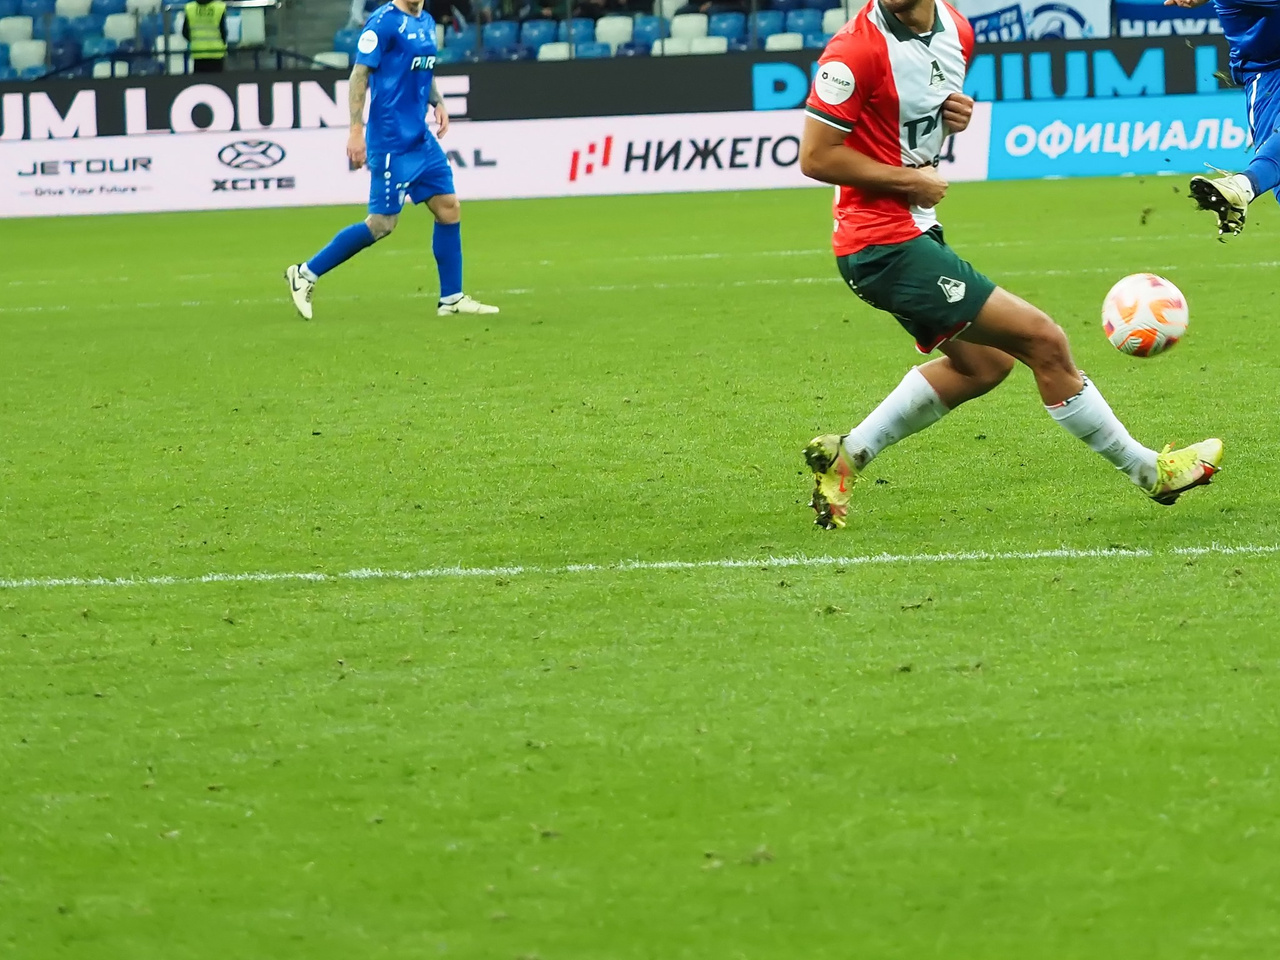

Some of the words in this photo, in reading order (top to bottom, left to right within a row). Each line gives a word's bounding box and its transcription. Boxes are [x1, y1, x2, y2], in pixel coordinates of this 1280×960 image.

[1004, 117, 1254, 159] ОФИЦИАЛЬ
[18, 156, 152, 177] JETOUR
[212, 176, 295, 192] XCITE
